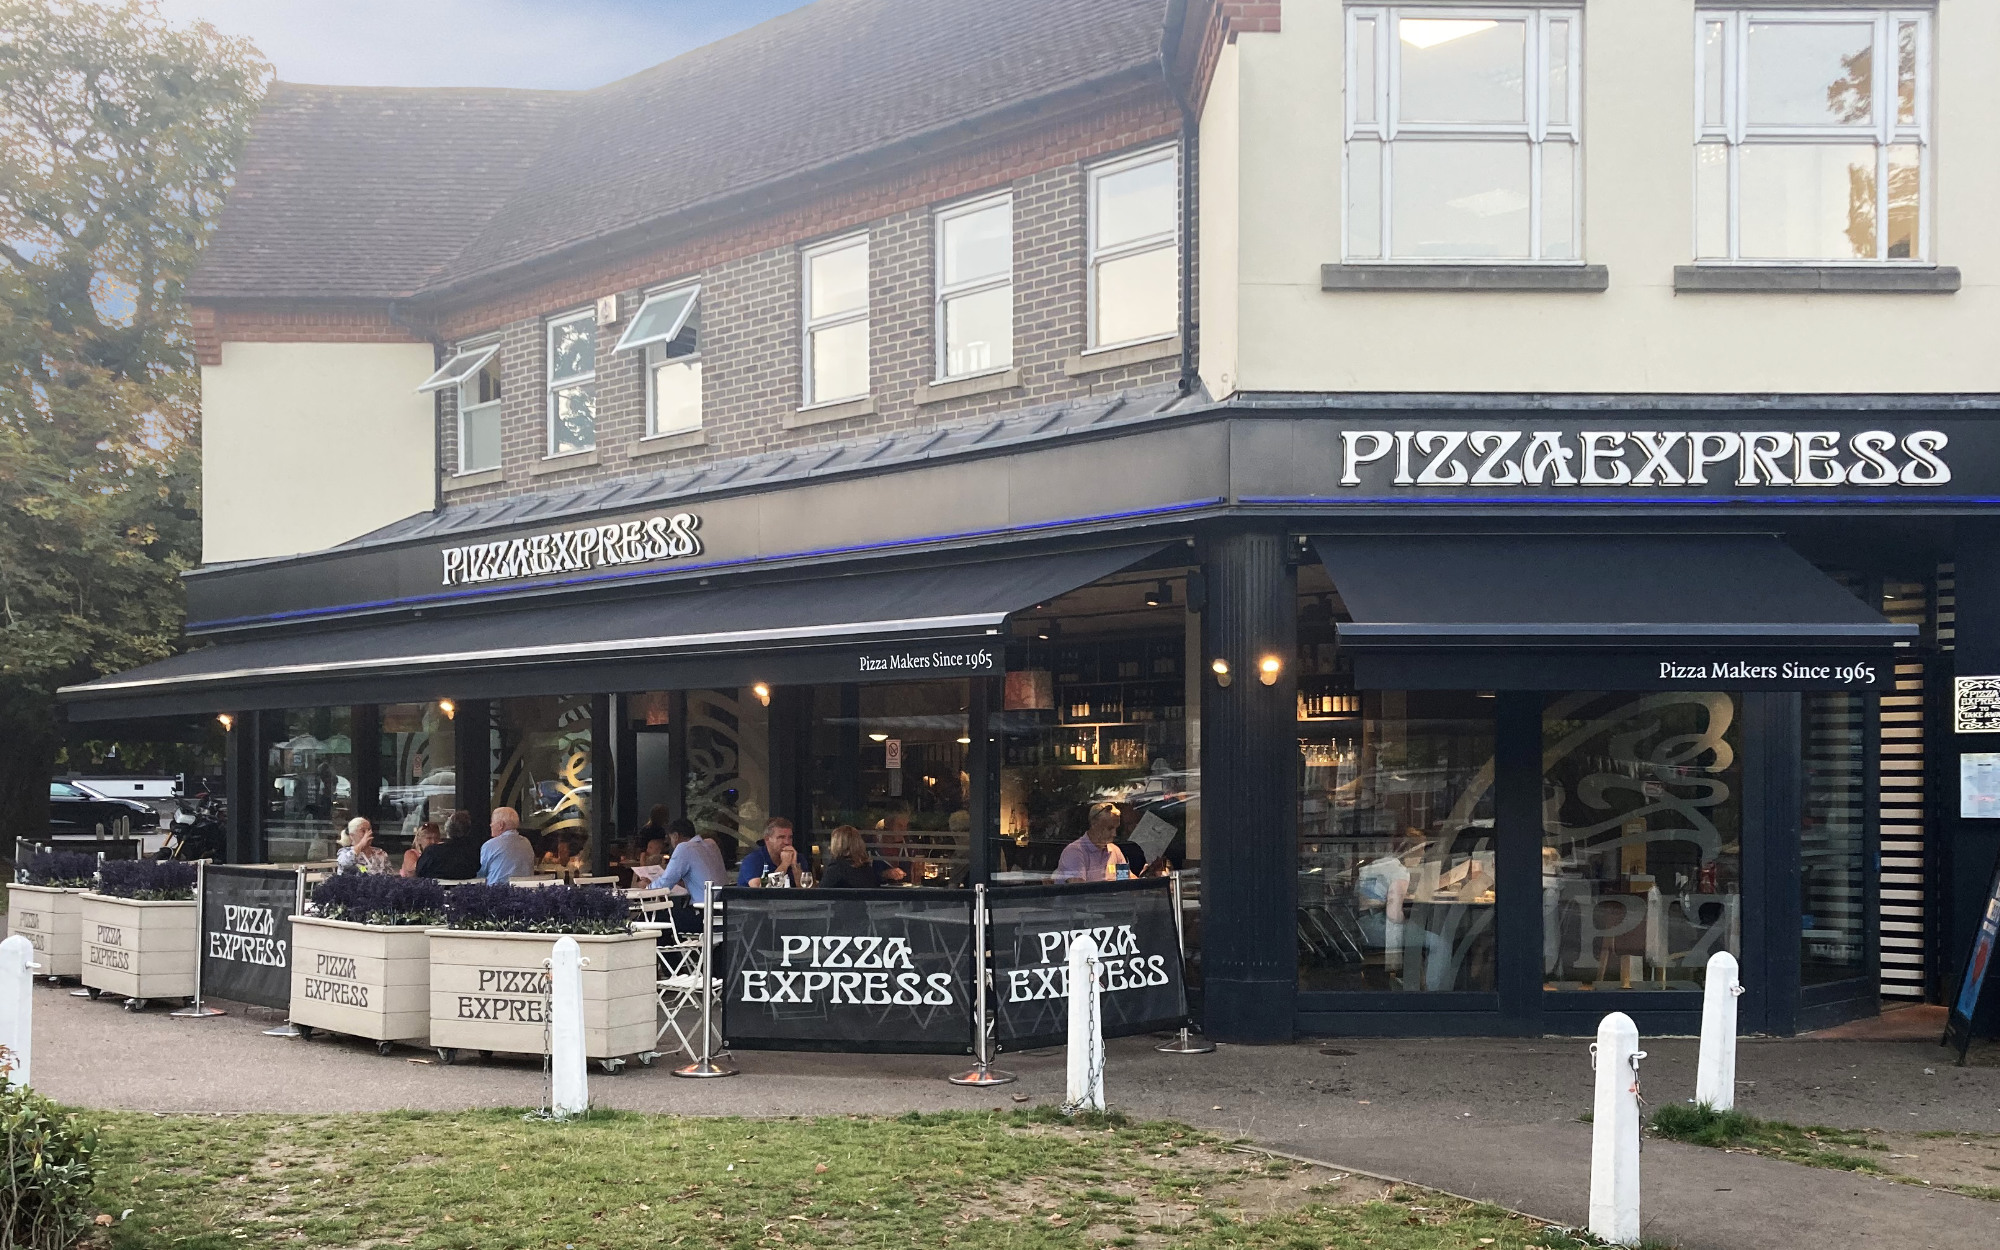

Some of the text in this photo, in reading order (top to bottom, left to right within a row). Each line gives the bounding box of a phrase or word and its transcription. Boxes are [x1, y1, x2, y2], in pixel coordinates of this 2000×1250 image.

[1338, 430, 1951, 487] PIZZAEXPRESS
[442, 513, 701, 586] PIZZAEXPRESS
[860, 649, 992, 671] Pizza Makers Since 1965
[1659, 661, 1875, 684] Pizza Makers Since 1965
[97, 924, 122, 947] PIZZA
[224, 904, 274, 936] PIZZA
[90, 946, 129, 970] EXPRESS
[209, 931, 287, 968] EXPRESS
[780, 935, 914, 969] PIZZA
[1038, 924, 1141, 964] PIZA
[317, 954, 356, 979] PIZZA
[1007, 955, 1169, 1003] EXESS
[305, 977, 368, 1008] EXPRESS
[741, 970, 954, 1005] EXPRESS
[458, 996, 552, 1023] EXPRE
